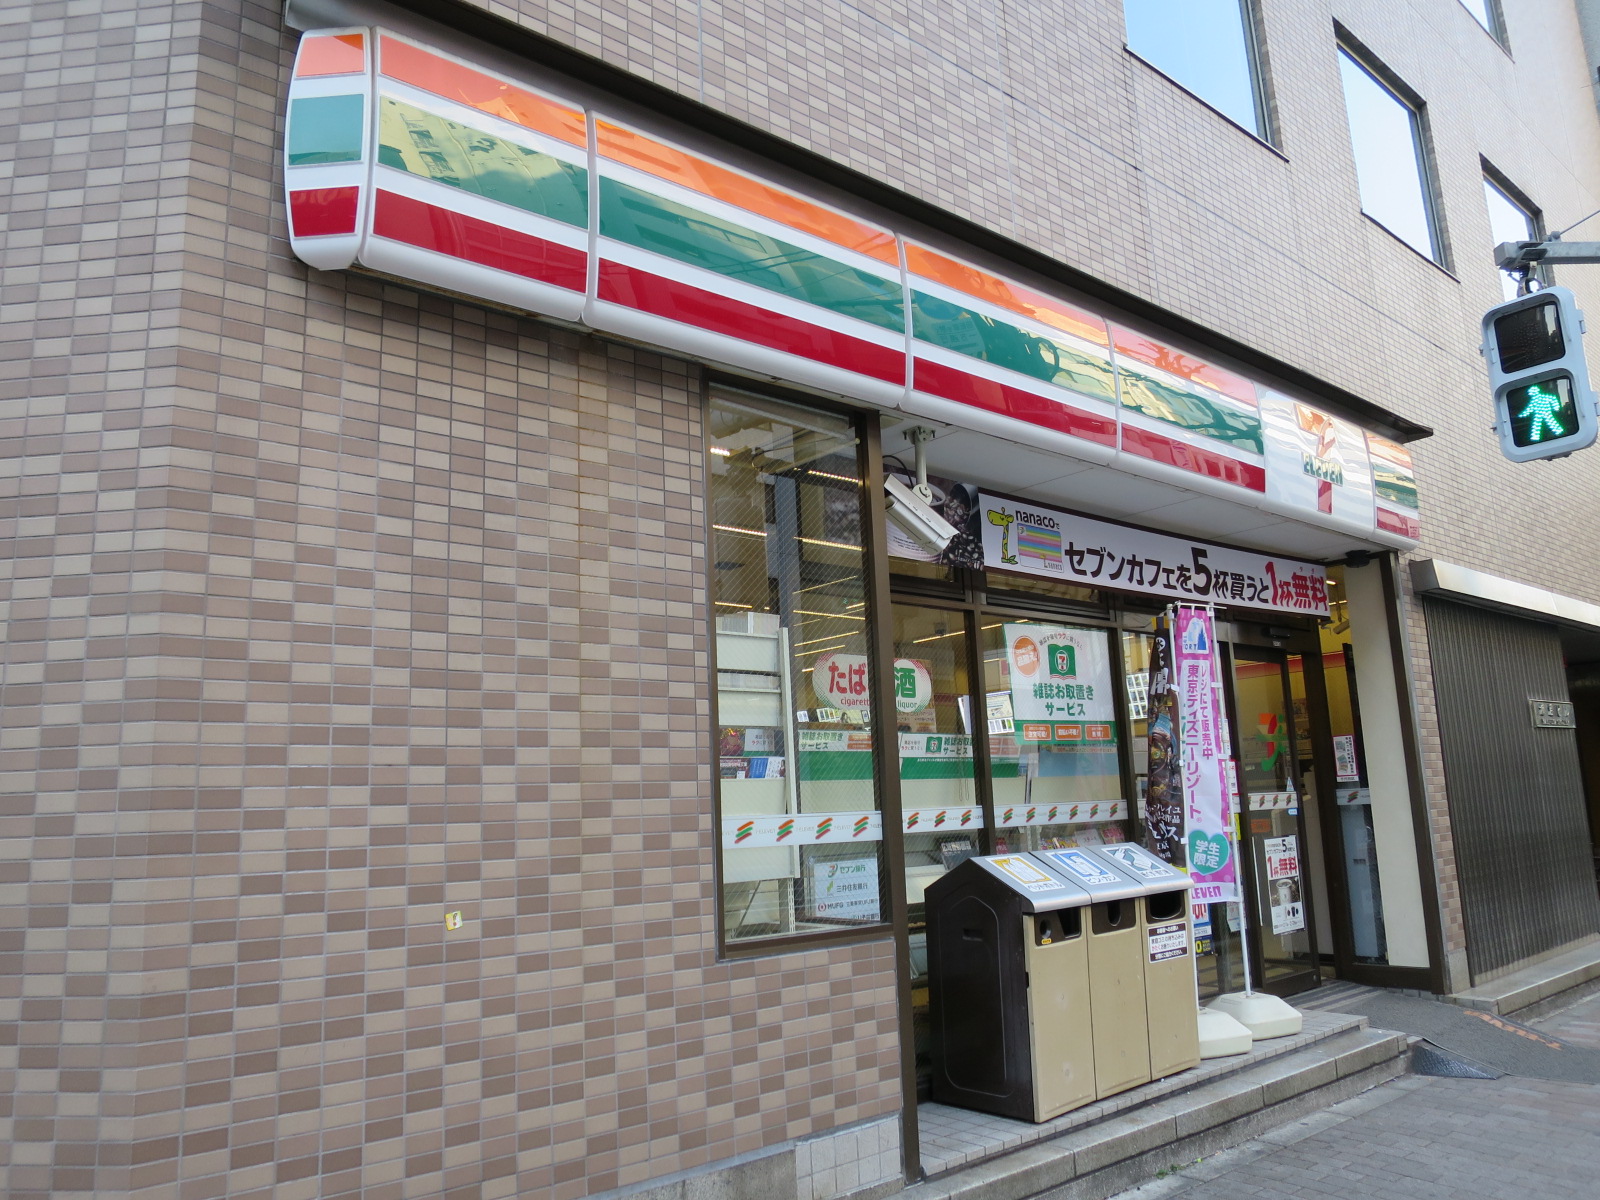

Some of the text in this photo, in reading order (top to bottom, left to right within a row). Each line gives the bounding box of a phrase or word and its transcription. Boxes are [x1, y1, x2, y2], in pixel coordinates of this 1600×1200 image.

[1065, 541, 1328, 611] セブンカフェを5杯買うと1杯無料
[828, 661, 869, 696] たば
[894, 667, 917, 698] 酒
[1033, 682, 1094, 700] 雑誌お取置き
[840, 697, 871, 708] cigarett
[897, 700, 918, 710] liquor
[1045, 702, 1086, 716] サービス
[1200, 664, 1214, 760] レジにて販売中
[1186, 664, 1202, 819] 東京ディズニーリゾート
[943, 747, 968, 755] サービス
[1195, 840, 1220, 856] 学生
[1193, 852, 1219, 869] 限定
[839, 864, 867, 874] セブン銀行
[836, 883, 868, 893] 三井住友銀行
[1191, 886, 1222, 899] LEVEn
